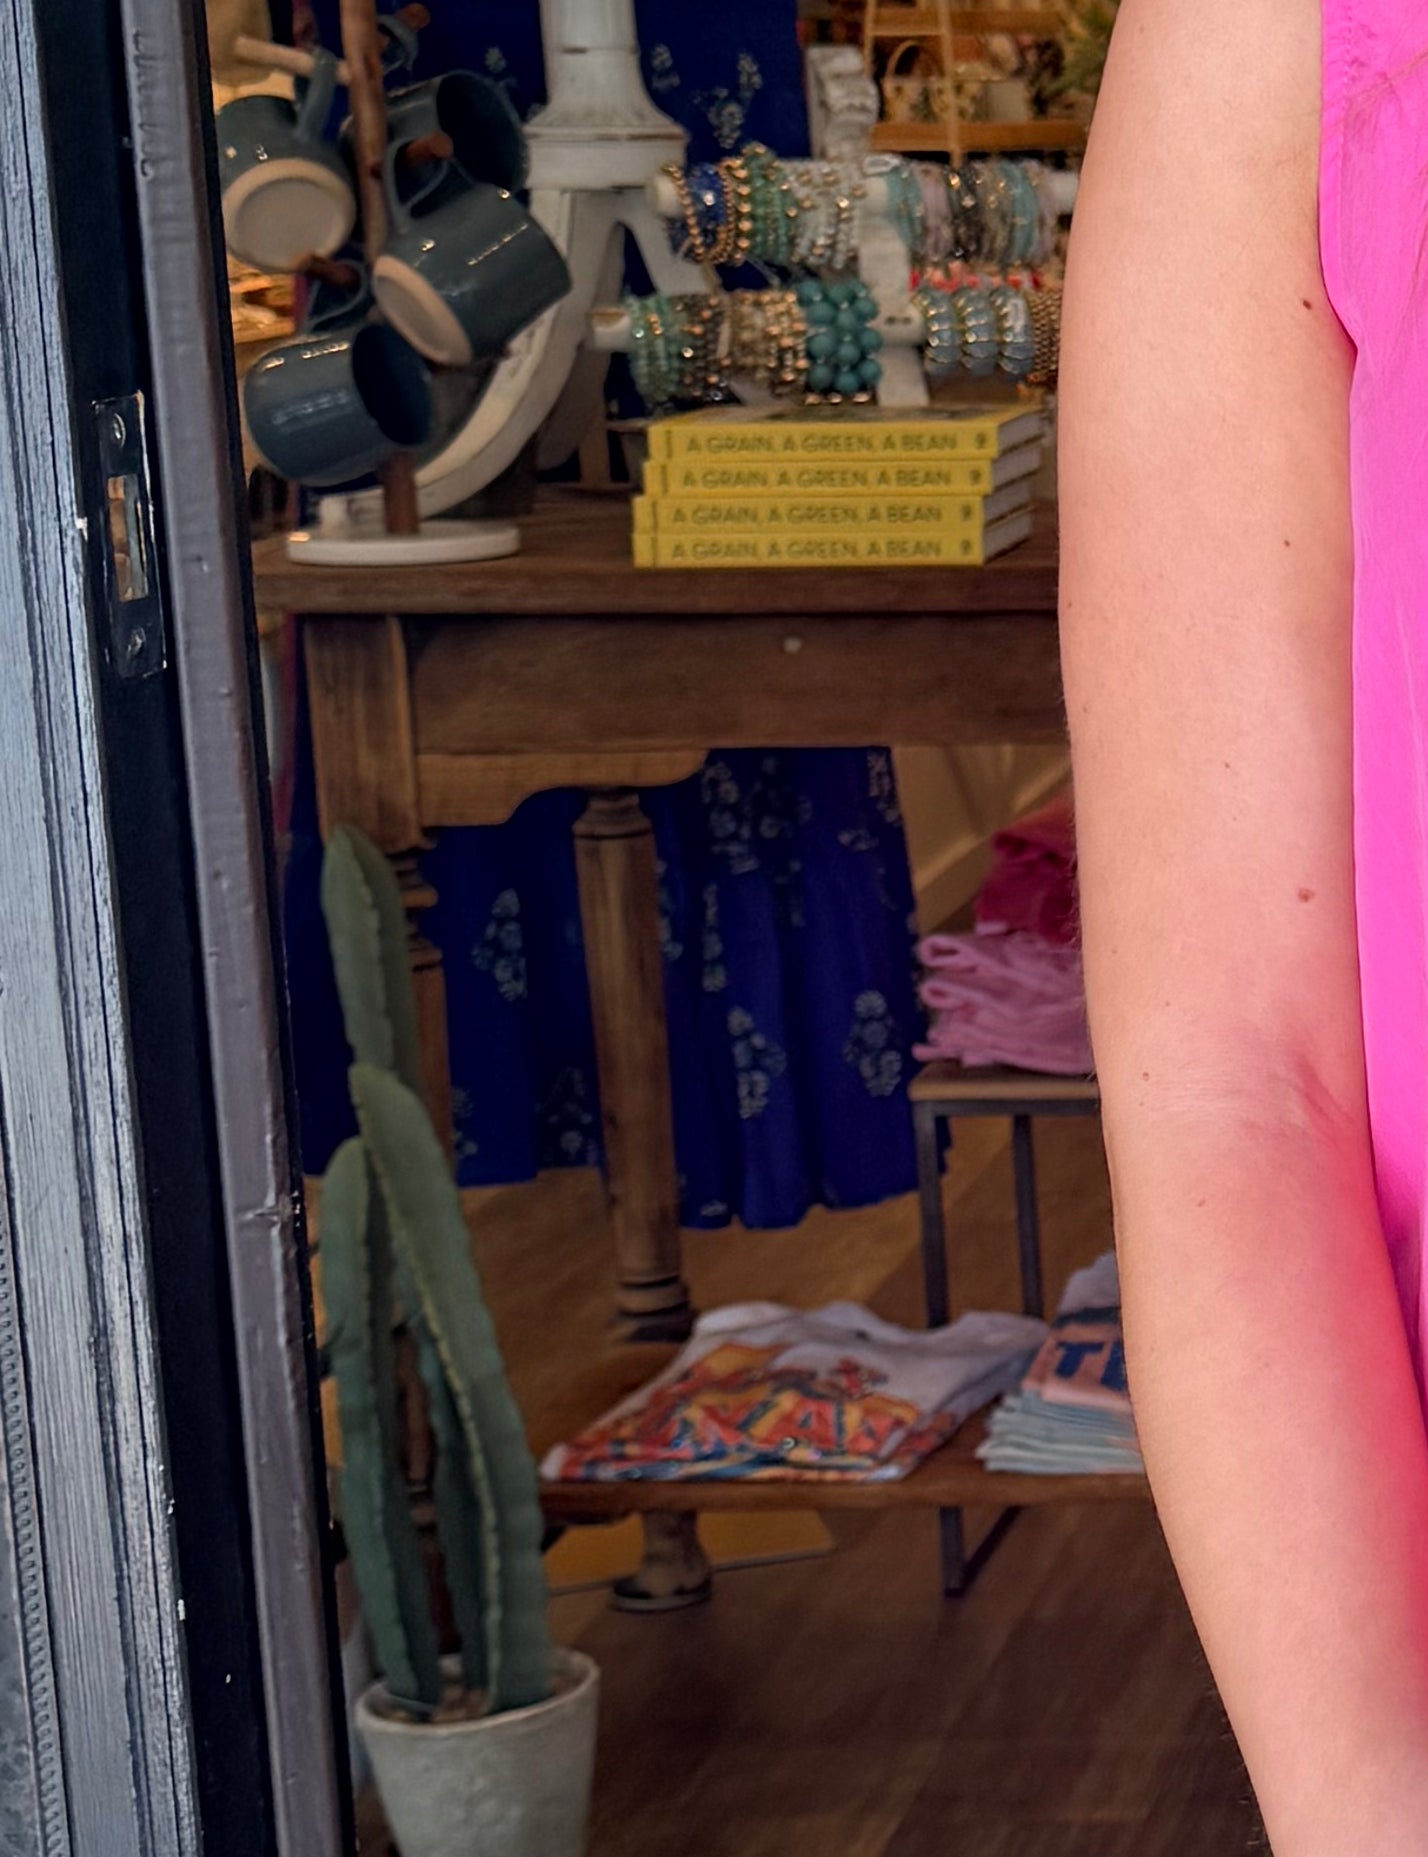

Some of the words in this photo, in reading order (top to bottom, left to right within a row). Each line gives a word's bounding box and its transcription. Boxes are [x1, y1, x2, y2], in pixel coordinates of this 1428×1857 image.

[686, 436, 700, 453] A
[783, 435, 796, 452] A
[883, 434, 896, 451] A
[901, 434, 957, 452] BEAN
[683, 470, 697, 487] A
[777, 469, 791, 486] A
[876, 469, 890, 486] A
[896, 469, 951, 486] BEAN
[673, 507, 687, 523] A
[767, 506, 782, 523] A
[867, 506, 881, 522] A
[886, 505, 942, 523] BEAN
[672, 543, 687, 559] A
[767, 542, 782, 558] A
[867, 541, 881, 557] A
[886, 541, 942, 558] BEAN
